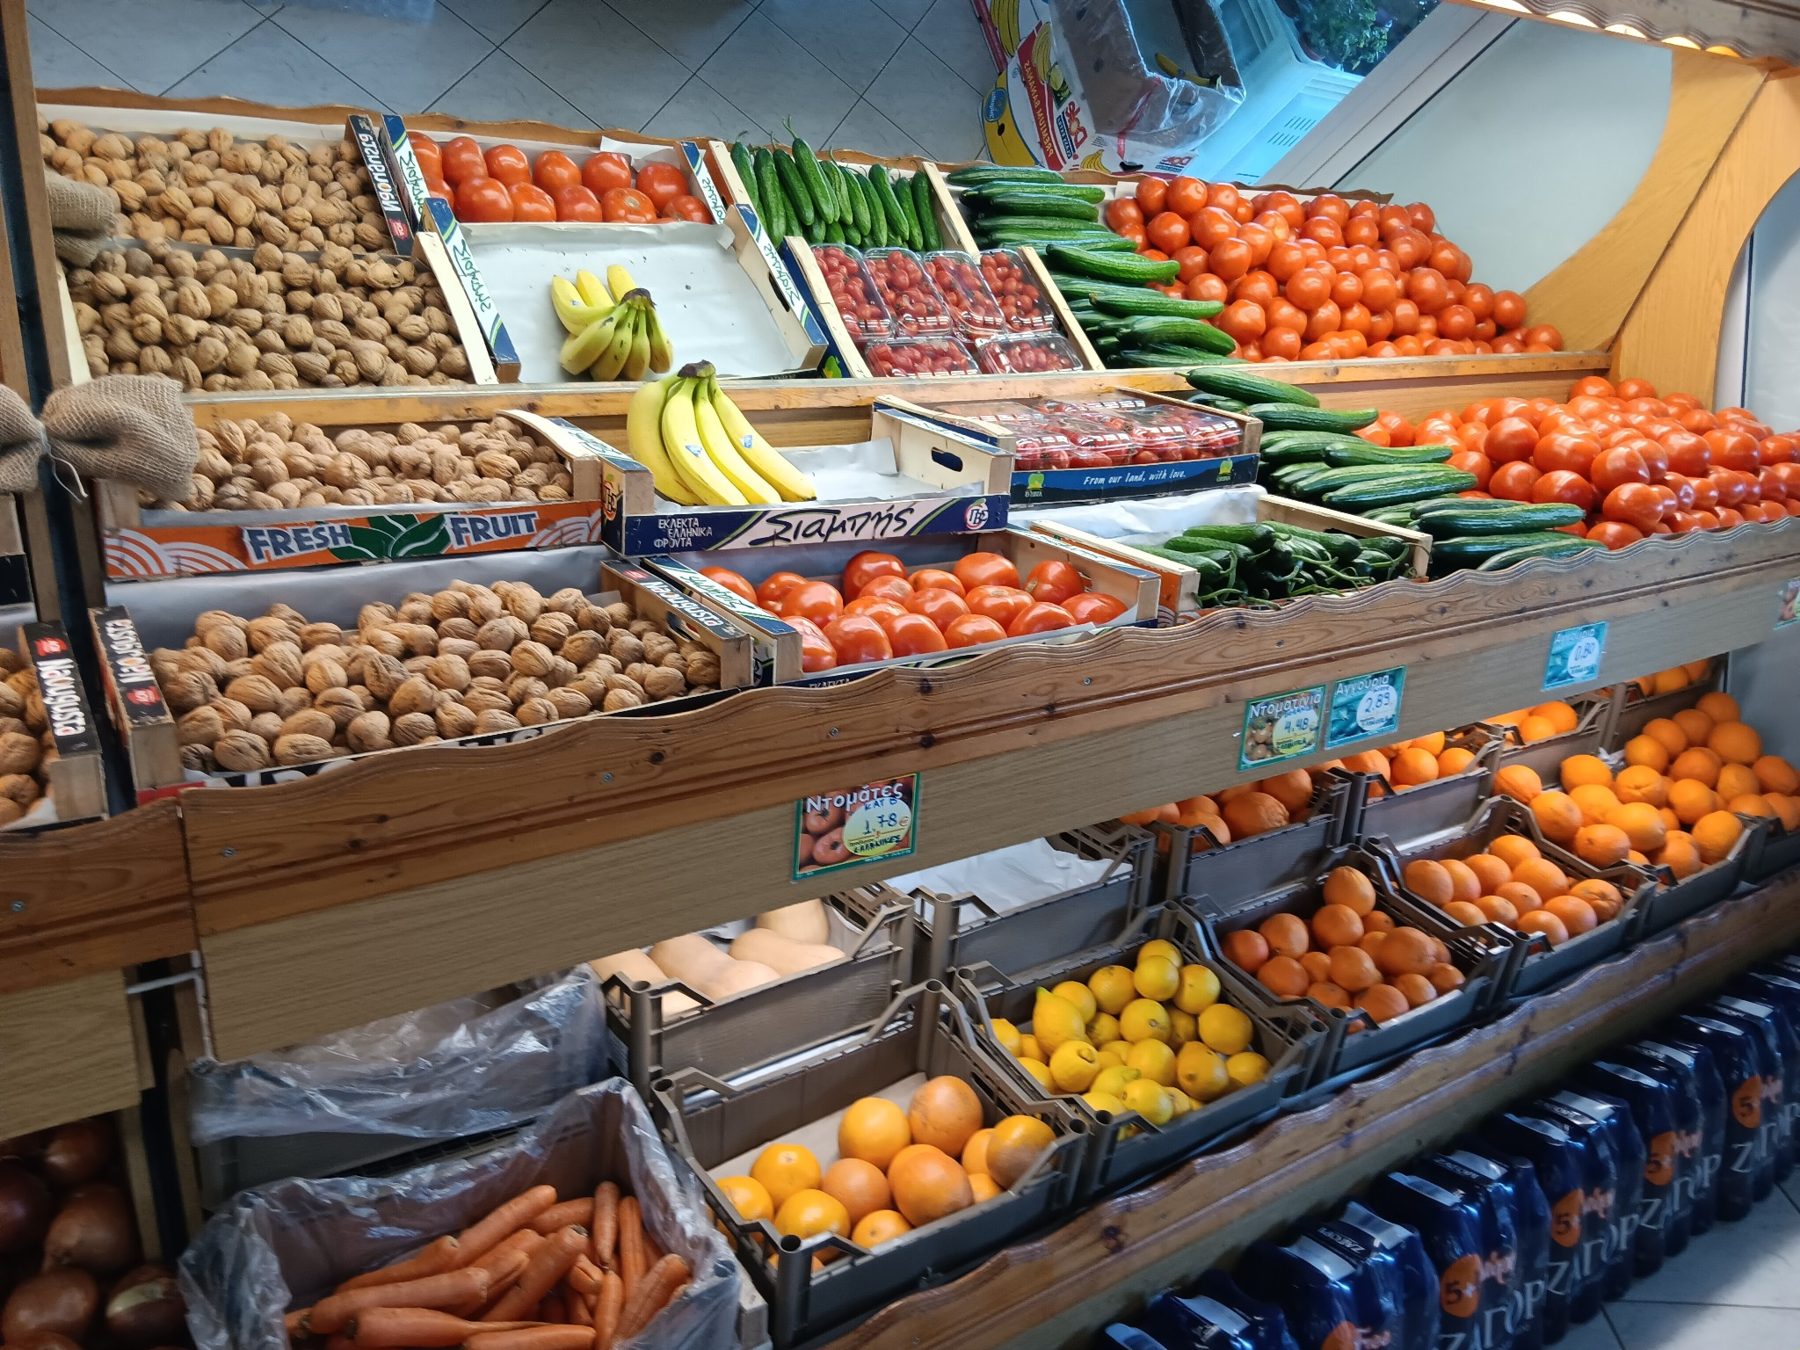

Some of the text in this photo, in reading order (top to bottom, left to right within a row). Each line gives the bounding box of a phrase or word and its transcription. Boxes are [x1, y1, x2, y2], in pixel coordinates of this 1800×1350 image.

[1083, 475, 1107, 486] From
[1108, 475, 1123, 484] our
[1125, 470, 1146, 484] land,
[1148, 469, 1168, 481] with
[658, 517, 700, 529] ΕΚΛΕΚΤΑ
[667, 526, 713, 539] ΕΛΛΗΝΙΚΑ
[749, 503, 916, 547] Σιαμπής
[248, 512, 537, 562] FRESH FRUIT
[653, 537, 693, 549] ΦΡΟΥΤΑ
[806, 782, 904, 814] Ντομάτες
[862, 811, 898, 835] 1.78
